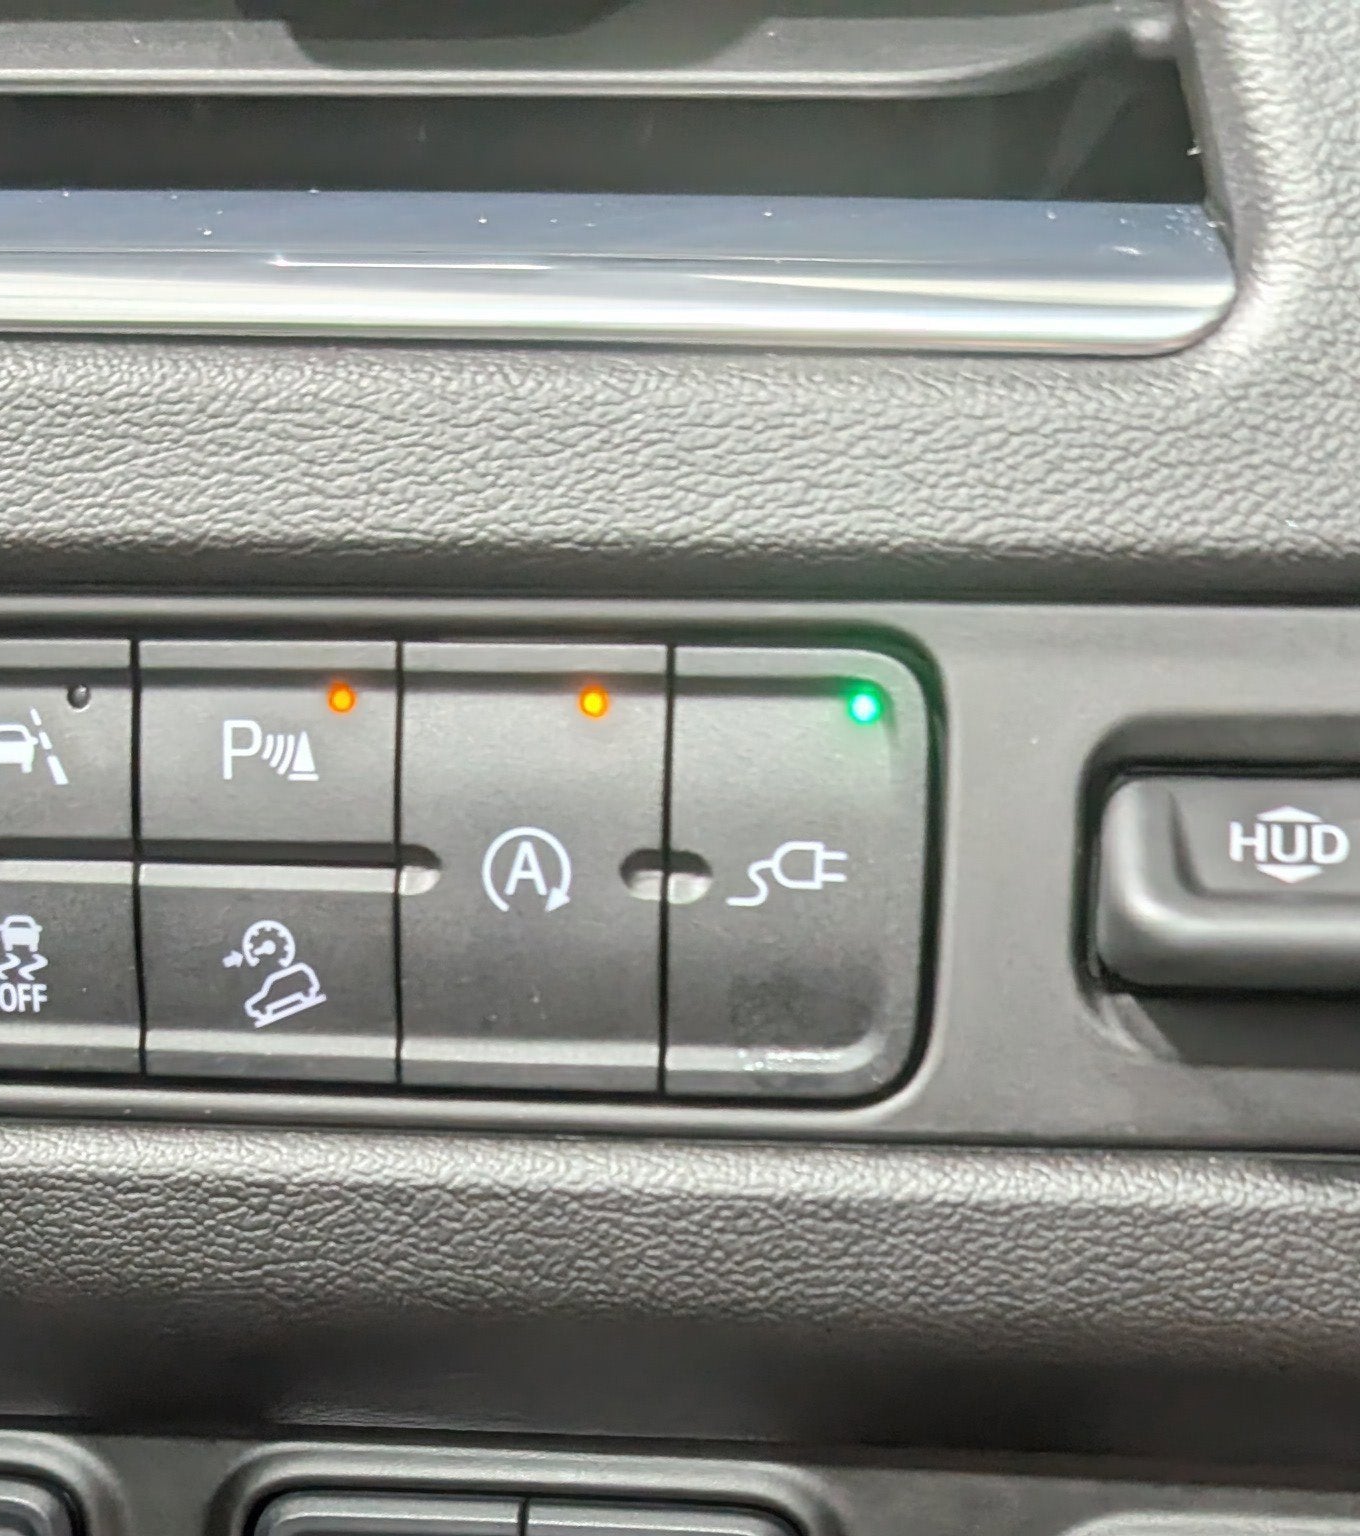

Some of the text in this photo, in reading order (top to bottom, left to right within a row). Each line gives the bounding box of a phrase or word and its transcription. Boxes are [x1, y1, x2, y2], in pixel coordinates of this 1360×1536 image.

[222, 719, 262, 779] P
[504, 842, 547, 896] A
[1228, 820, 1351, 865] HUD
